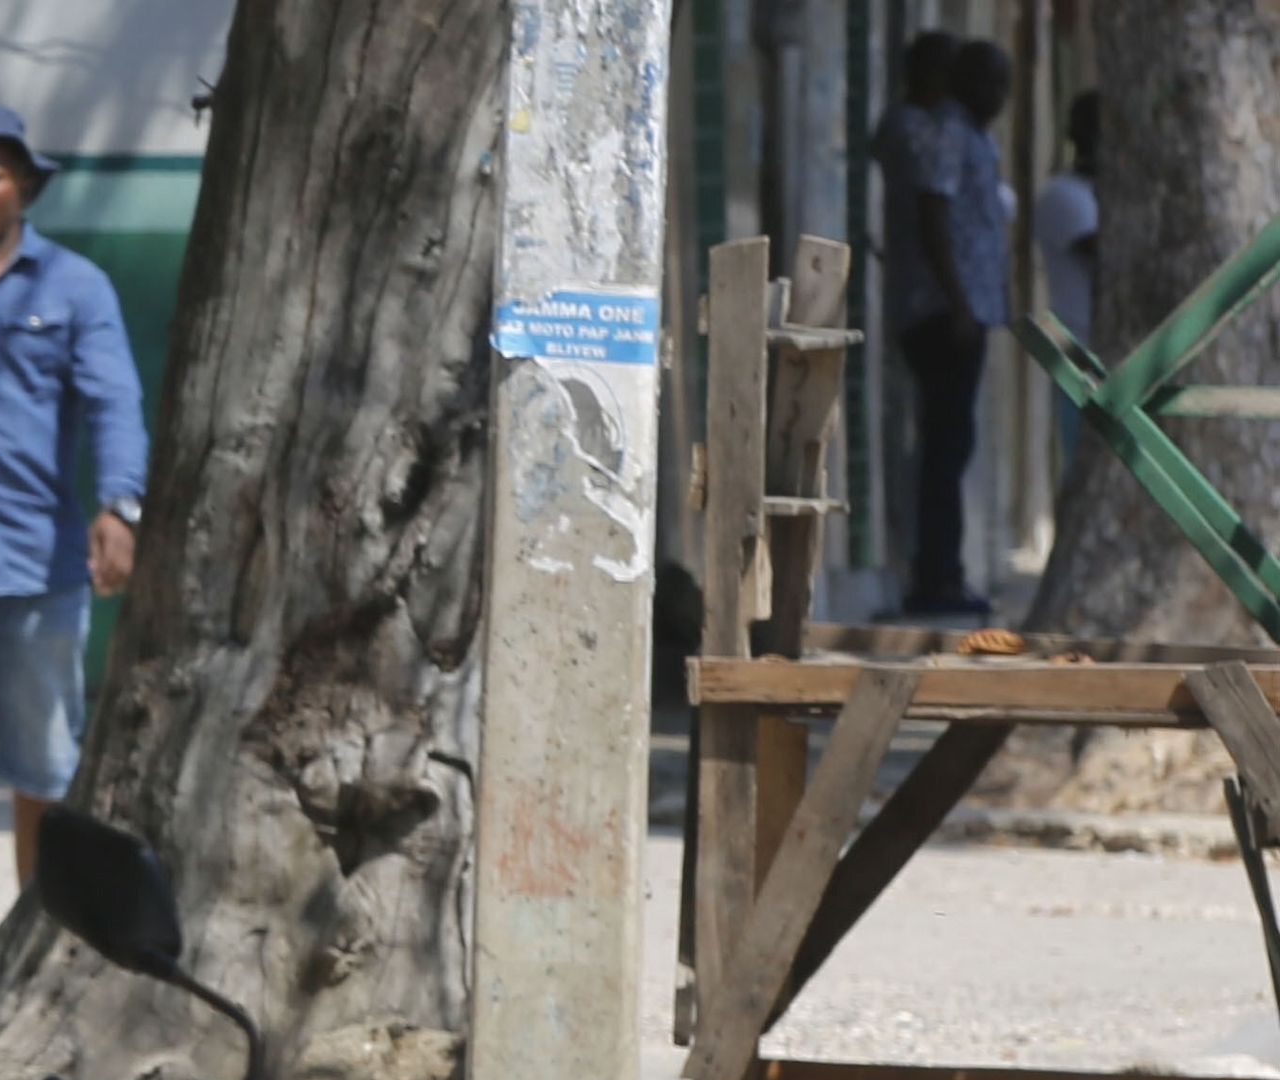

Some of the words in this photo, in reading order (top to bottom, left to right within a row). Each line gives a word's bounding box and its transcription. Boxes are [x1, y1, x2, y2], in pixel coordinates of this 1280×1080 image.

[598, 304, 644, 324] ONE
[529, 322, 574, 338] MOTO
[579, 325, 609, 340] PAP
[545, 341, 607, 358] BLIYEW
